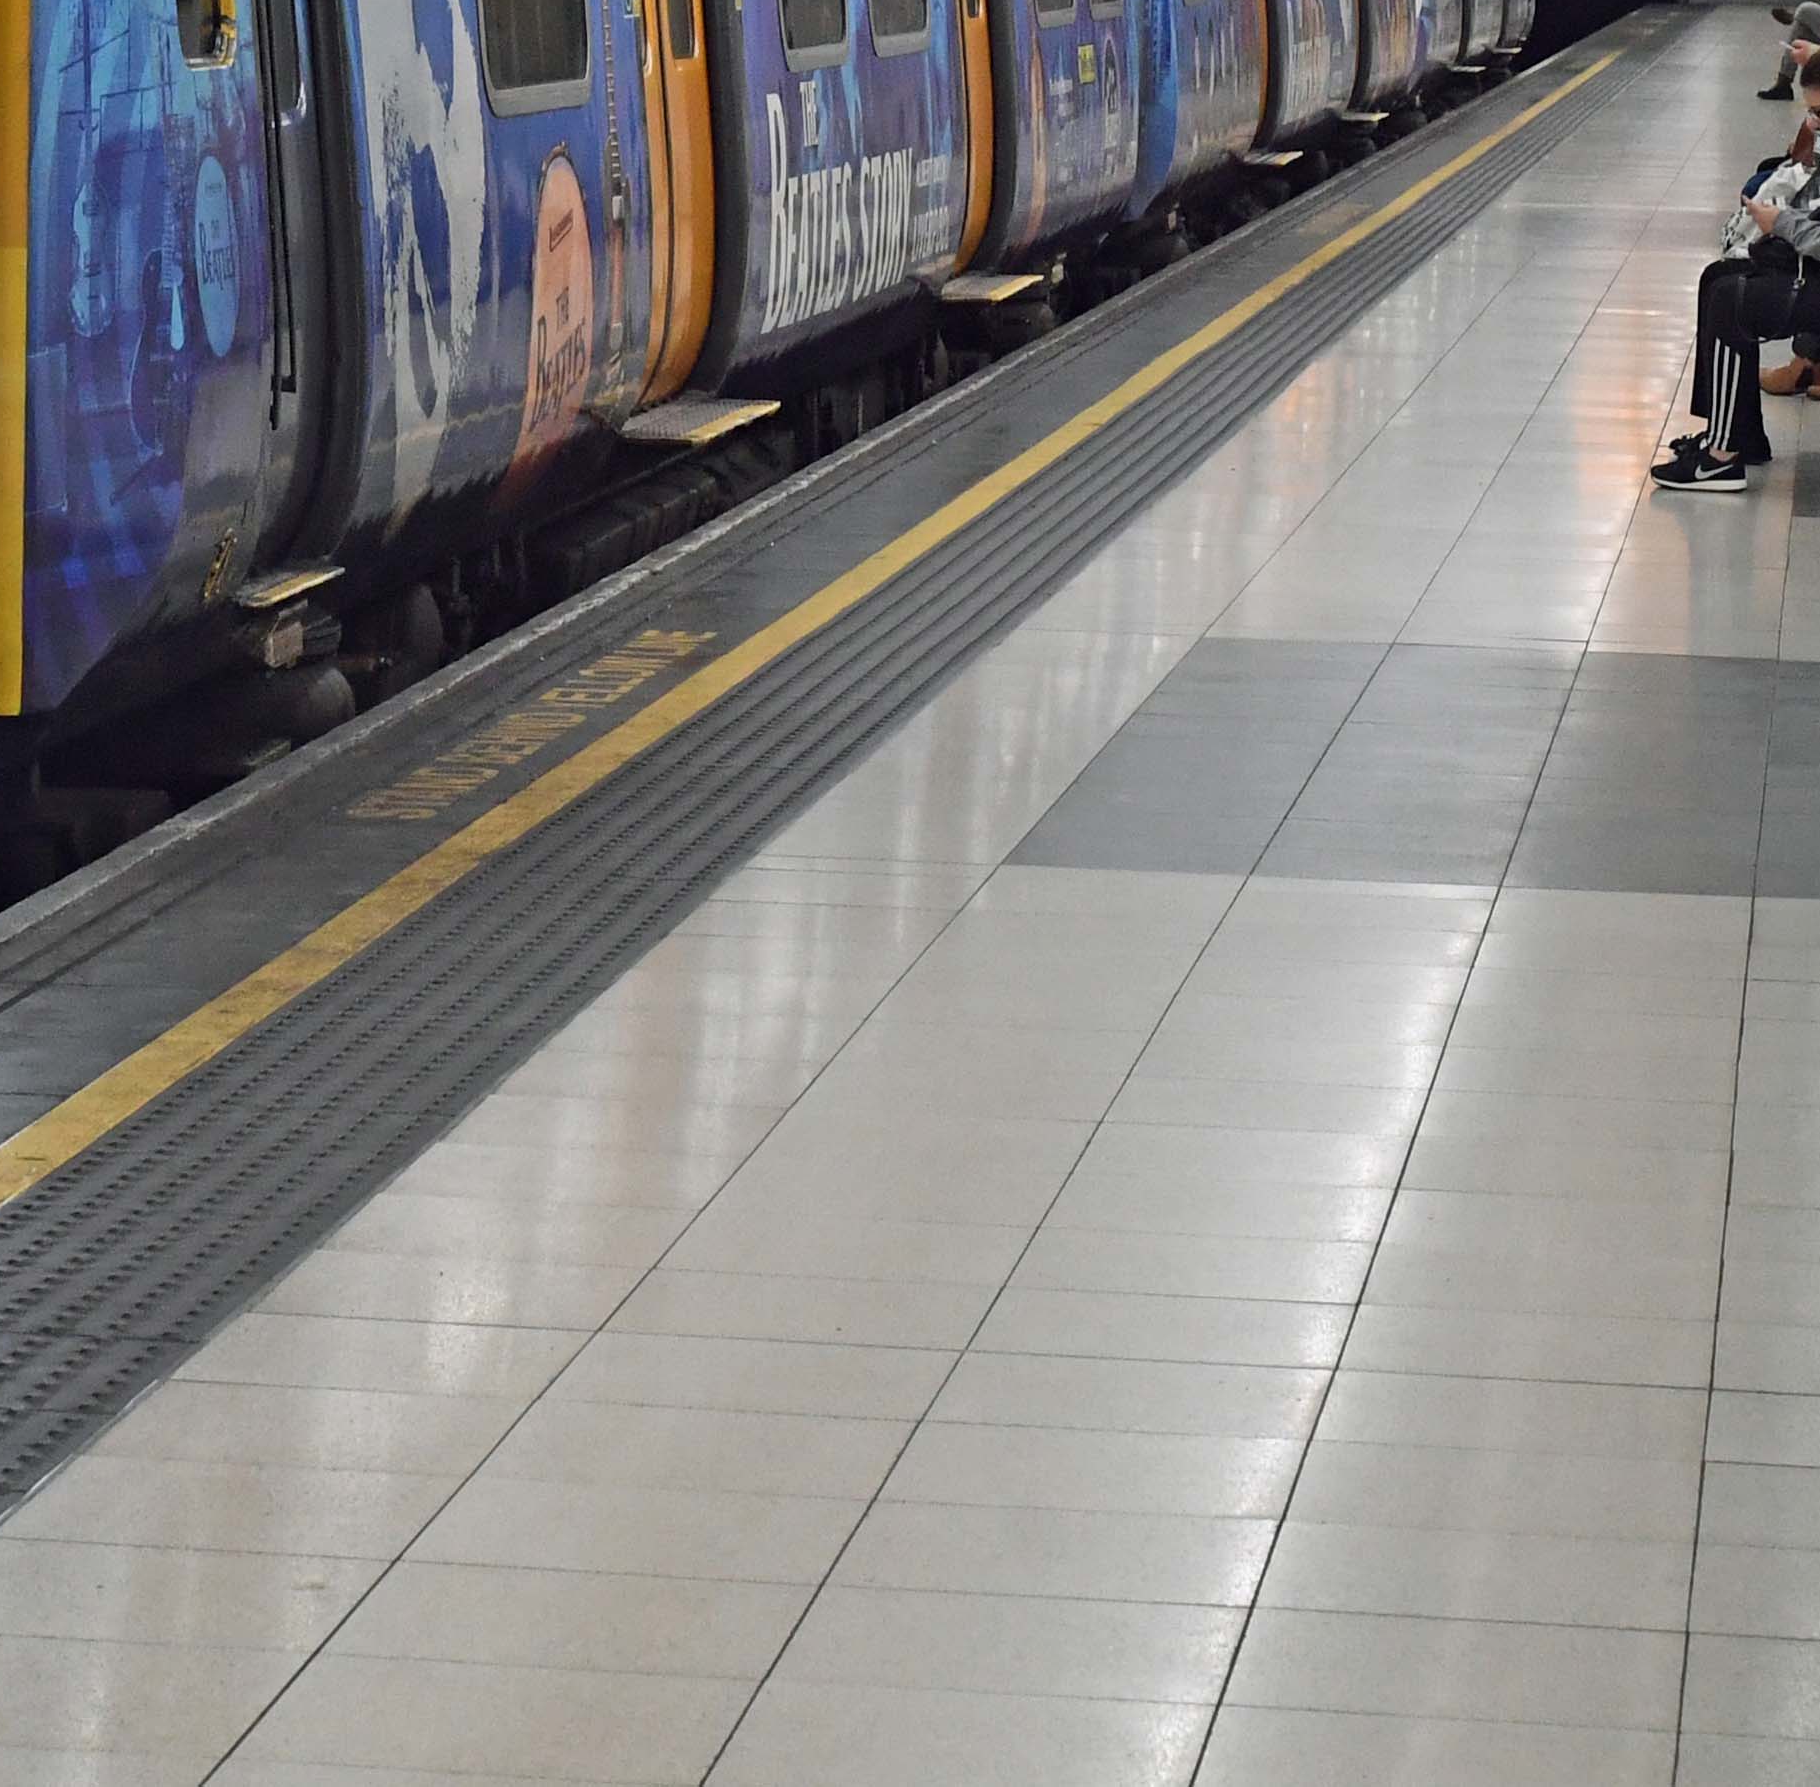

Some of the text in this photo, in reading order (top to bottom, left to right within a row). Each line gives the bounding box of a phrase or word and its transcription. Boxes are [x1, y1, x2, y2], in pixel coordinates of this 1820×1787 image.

[799, 81, 819, 148] THE
[760, 93, 914, 335] BEATLES STORY
